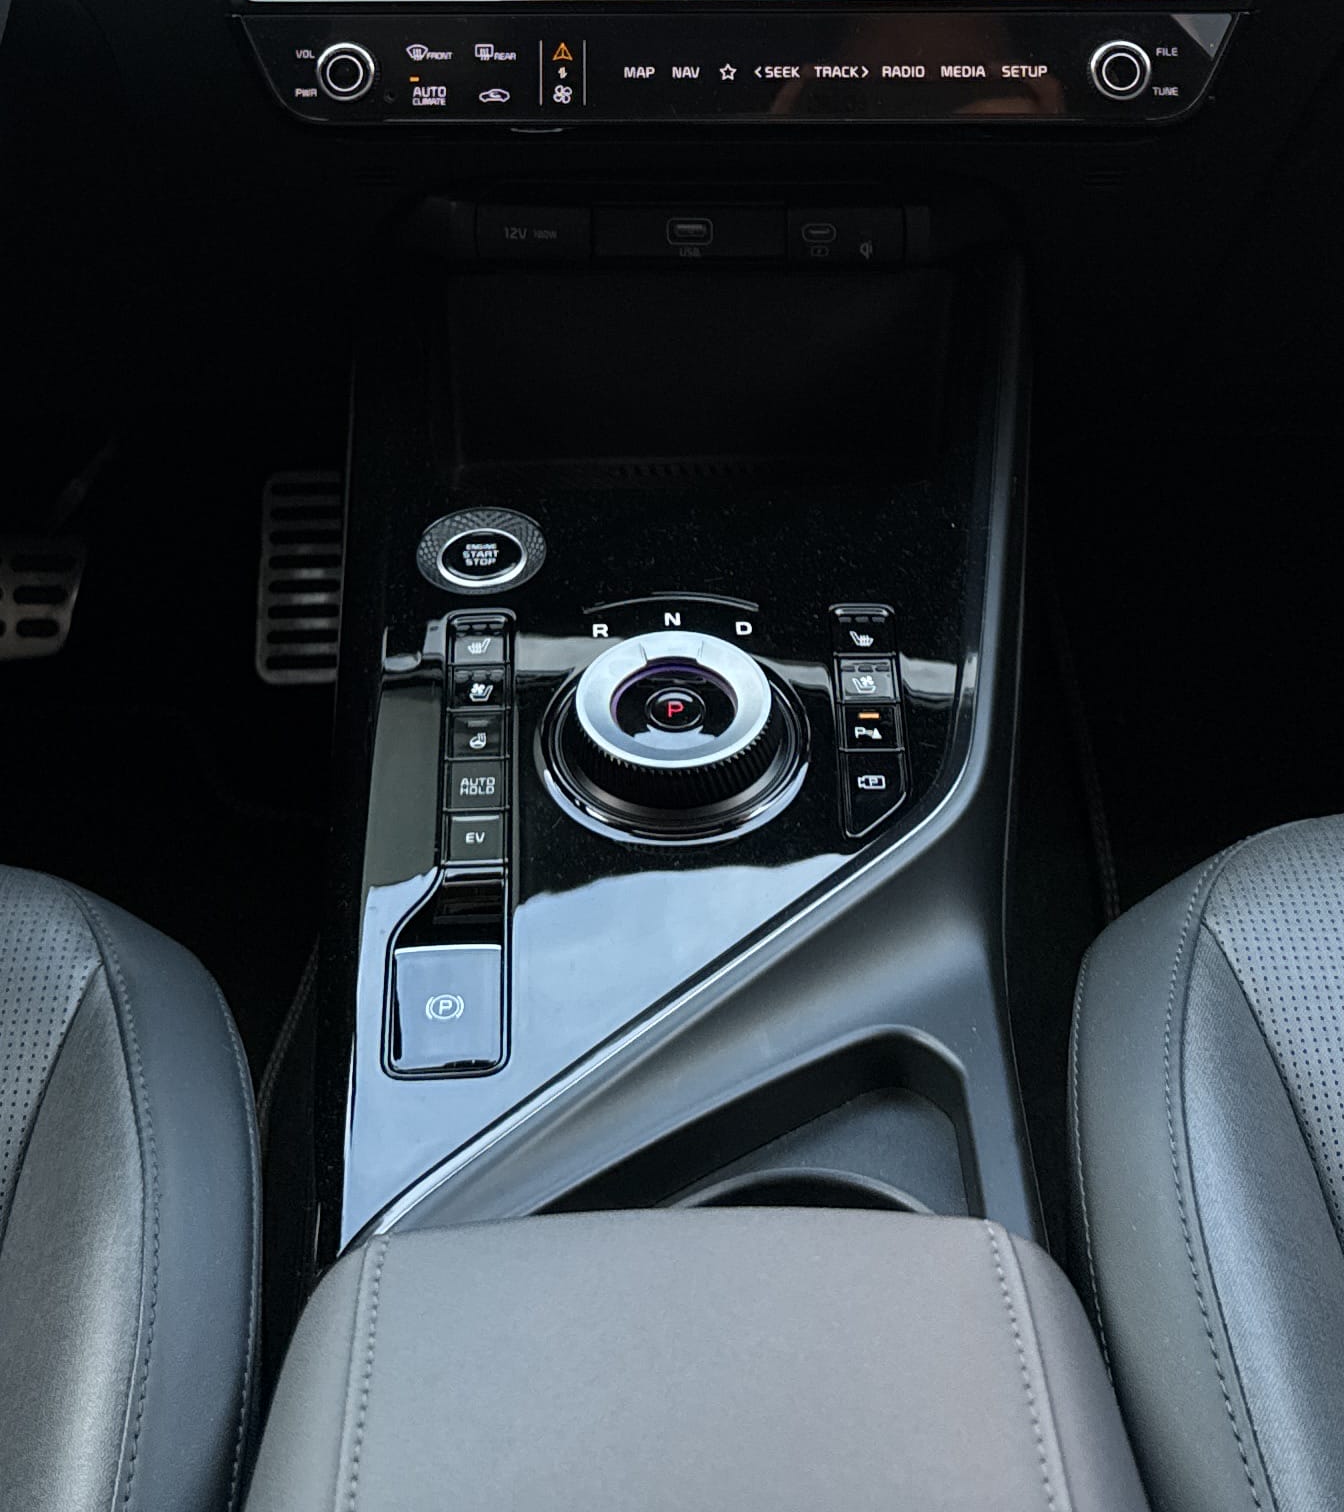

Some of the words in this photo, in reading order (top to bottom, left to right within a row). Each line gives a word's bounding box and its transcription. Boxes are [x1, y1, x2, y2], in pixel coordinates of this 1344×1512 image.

[295, 49, 316, 60] VOL
[426, 51, 453, 60] FRONT
[493, 51, 517, 61] REAR
[1156, 46, 1179, 57] FILE
[624, 66, 656, 79] MAP
[672, 66, 701, 79] NAV
[881, 65, 925, 78] RADIO
[940, 65, 986, 78] MEDIA
[1001, 65, 1048, 78] SETUP
[294, 88, 318, 98] PWR
[412, 85, 447, 98] AUTO
[1151, 86, 1179, 97] TUNE
[412, 97, 446, 106] CLIMATE
[504, 226, 528, 240] 12V
[462, 550, 499, 559] START
[465, 558, 496, 566] STOP
[592, 624, 609, 638] R
[664, 612, 681, 626] N
[735, 621, 752, 635] D
[667, 701, 684, 718] P
[460, 776, 496, 786] AUTO
[459, 785, 495, 796] HOLD
[465, 831, 485, 844] EV
